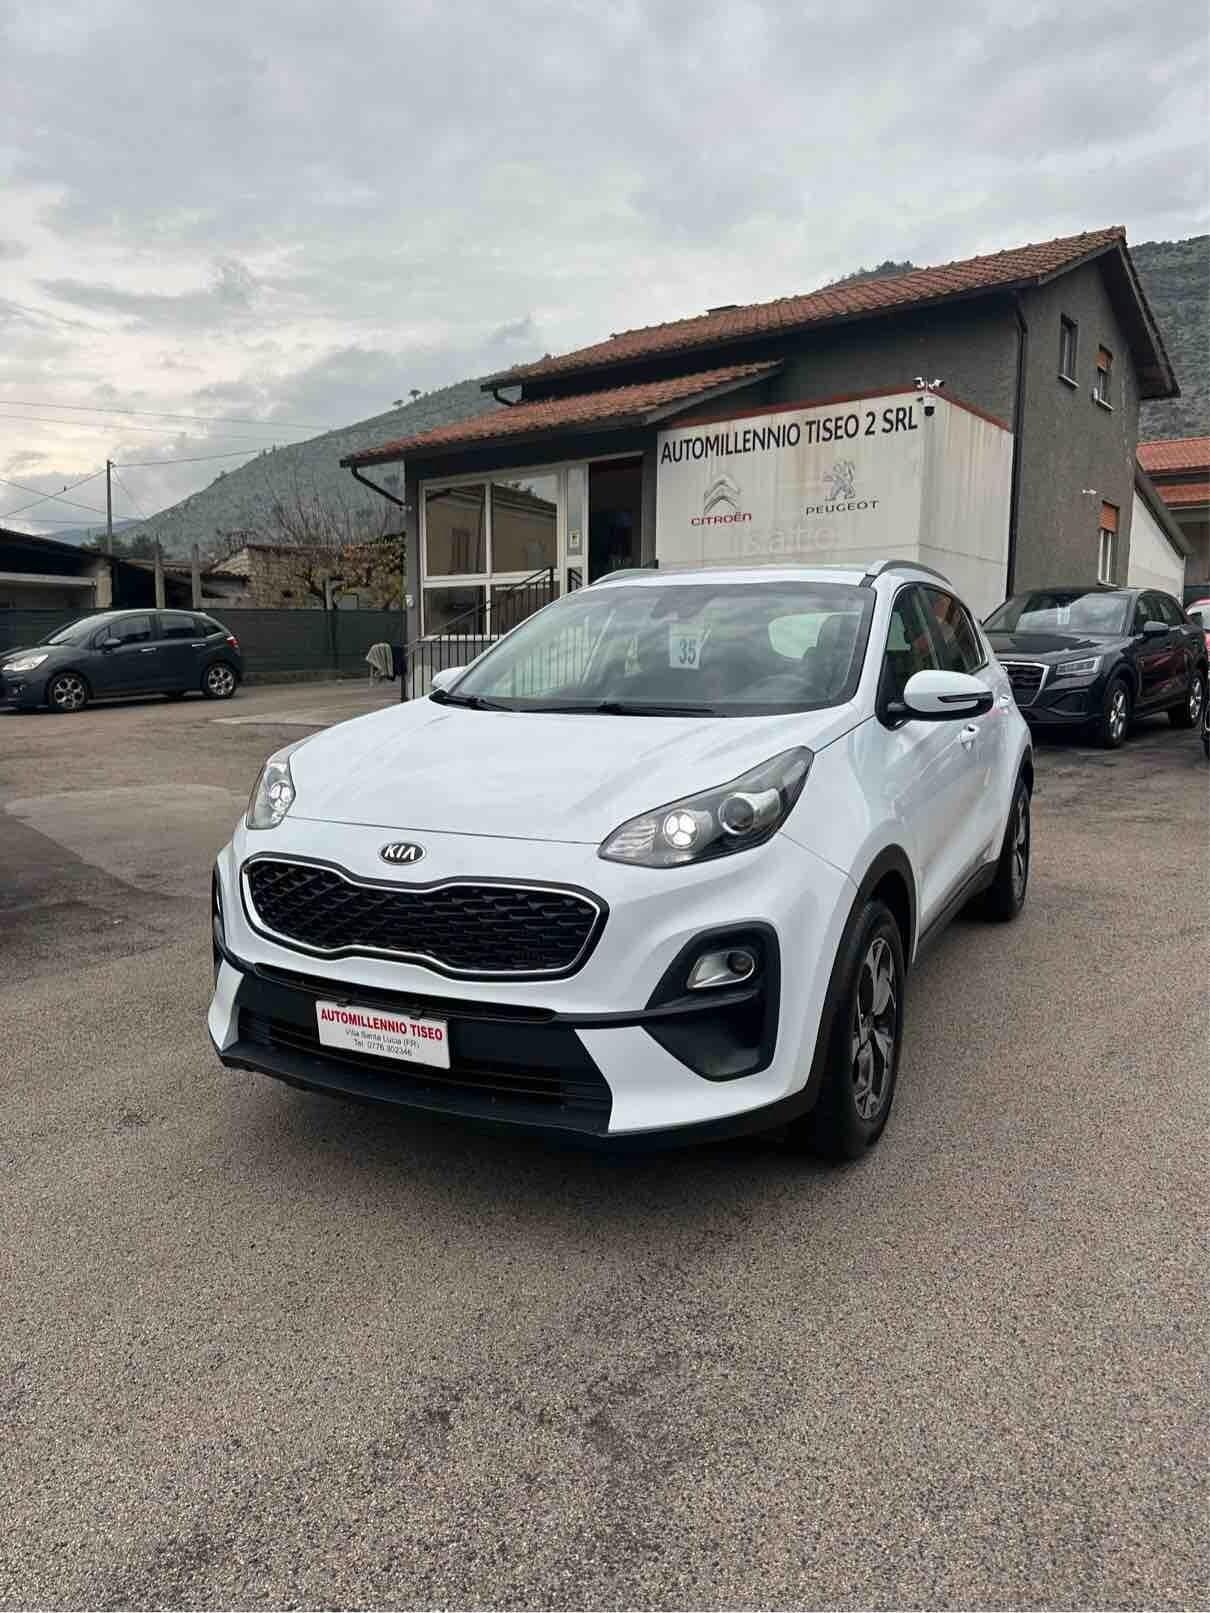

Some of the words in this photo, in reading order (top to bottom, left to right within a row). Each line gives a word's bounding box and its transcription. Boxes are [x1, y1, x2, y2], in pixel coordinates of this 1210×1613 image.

[660, 422, 801, 465] AUTOMILLENNIO
[805, 413, 860, 445] TISEO
[864, 411, 876, 436] 2
[881, 404, 919, 434] SRL
[805, 499, 880, 516] PEUGEOT
[384, 844, 417, 861] KIA
[321, 1008, 407, 1034] AUTOMILLENNIO
[410, 1023, 443, 1041] TISEO
